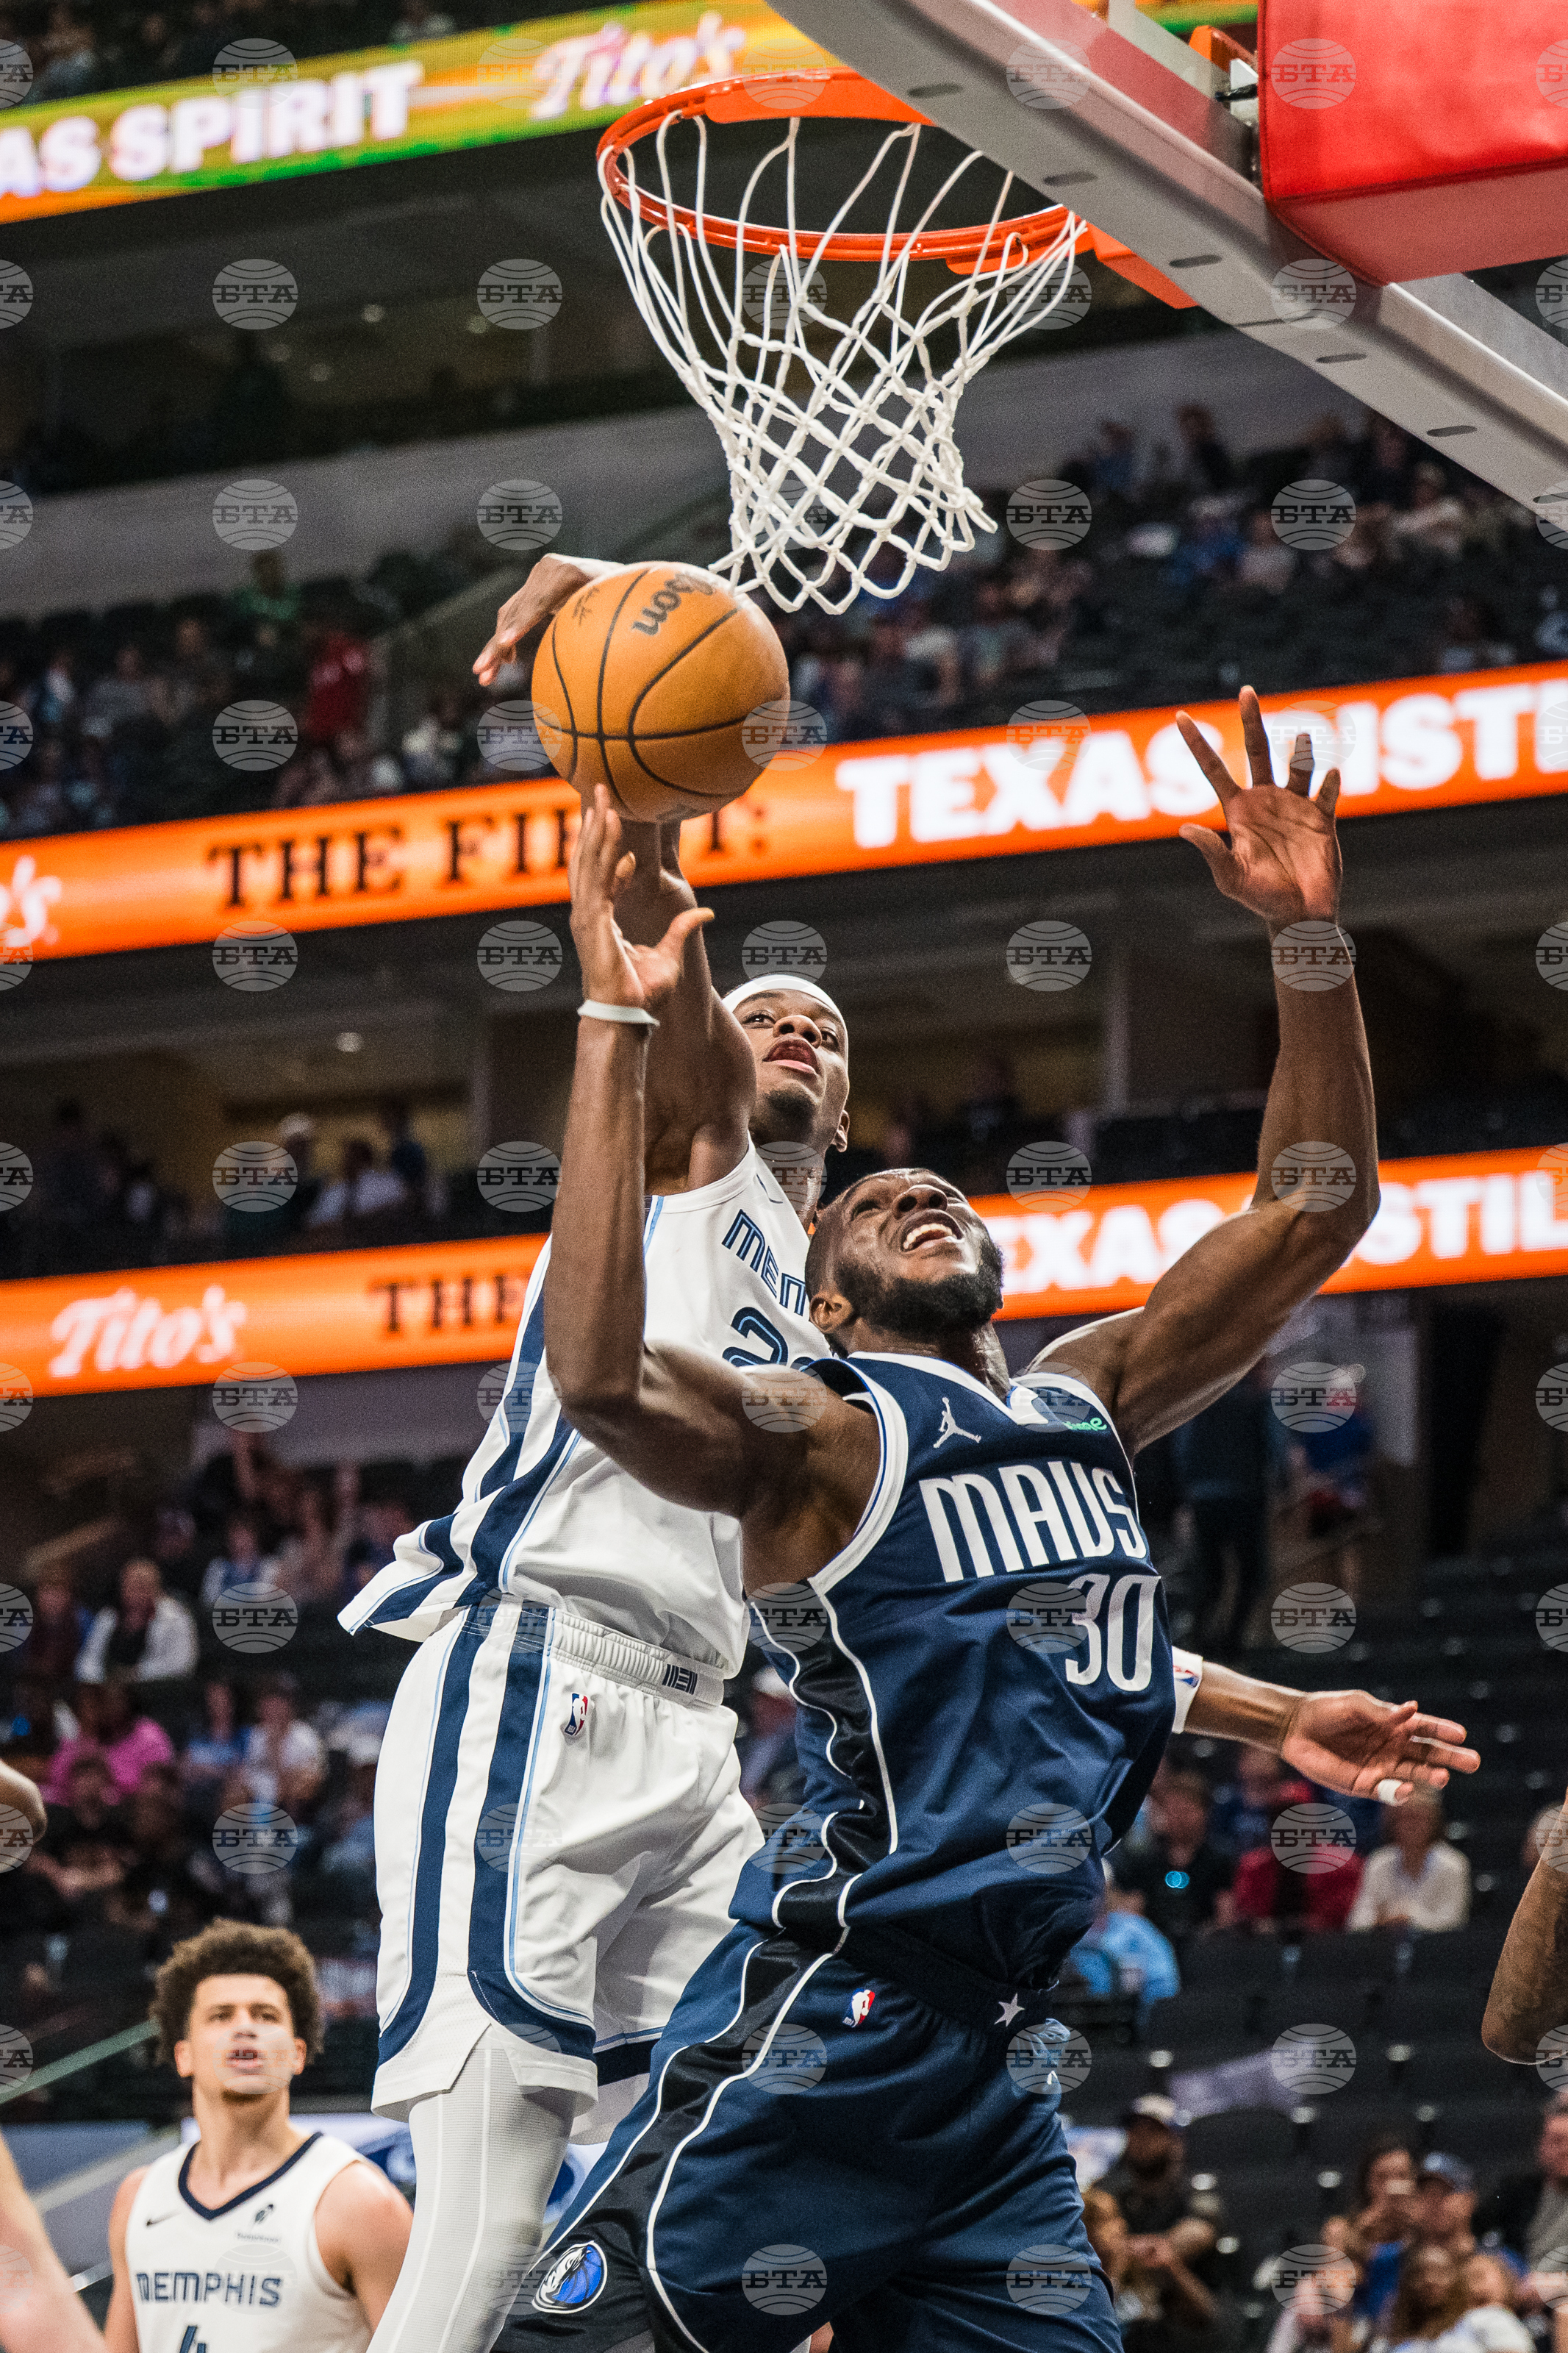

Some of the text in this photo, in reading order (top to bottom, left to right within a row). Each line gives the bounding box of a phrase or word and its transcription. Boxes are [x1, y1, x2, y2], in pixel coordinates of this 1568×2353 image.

[109, 60, 425, 182] SPIRIT
[835, 719, 1226, 849] TEXAS
[206, 825, 403, 909] THE
[49, 1285, 248, 1378] Tito's
[919, 1461, 1147, 1583] MAVS
[1065, 1574, 1162, 1692] 30
